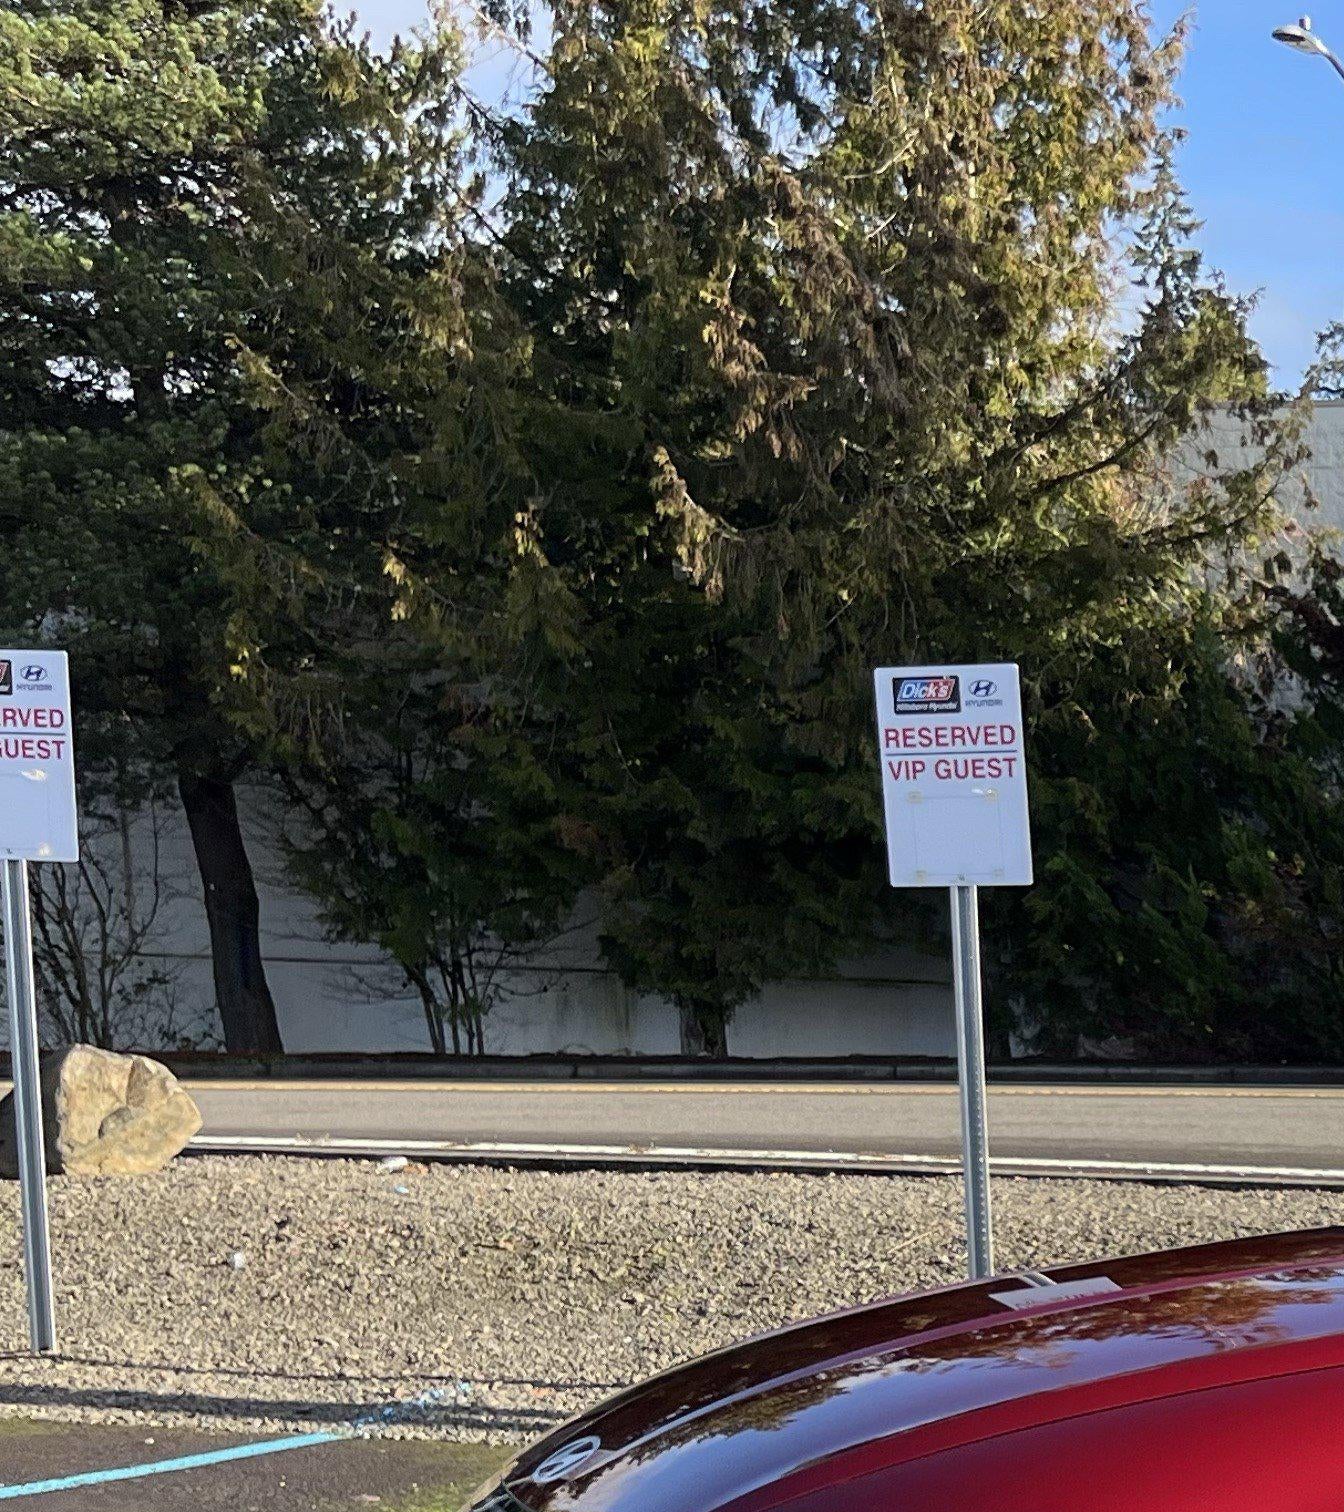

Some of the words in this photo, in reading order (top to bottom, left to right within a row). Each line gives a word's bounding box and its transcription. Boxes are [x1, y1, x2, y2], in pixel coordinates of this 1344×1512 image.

[0, 708, 64, 728] RVED
[884, 724, 1016, 748] RESERVED
[0, 738, 65, 760] UEST
[888, 760, 925, 781] VIP
[934, 757, 1017, 780] GUEST
